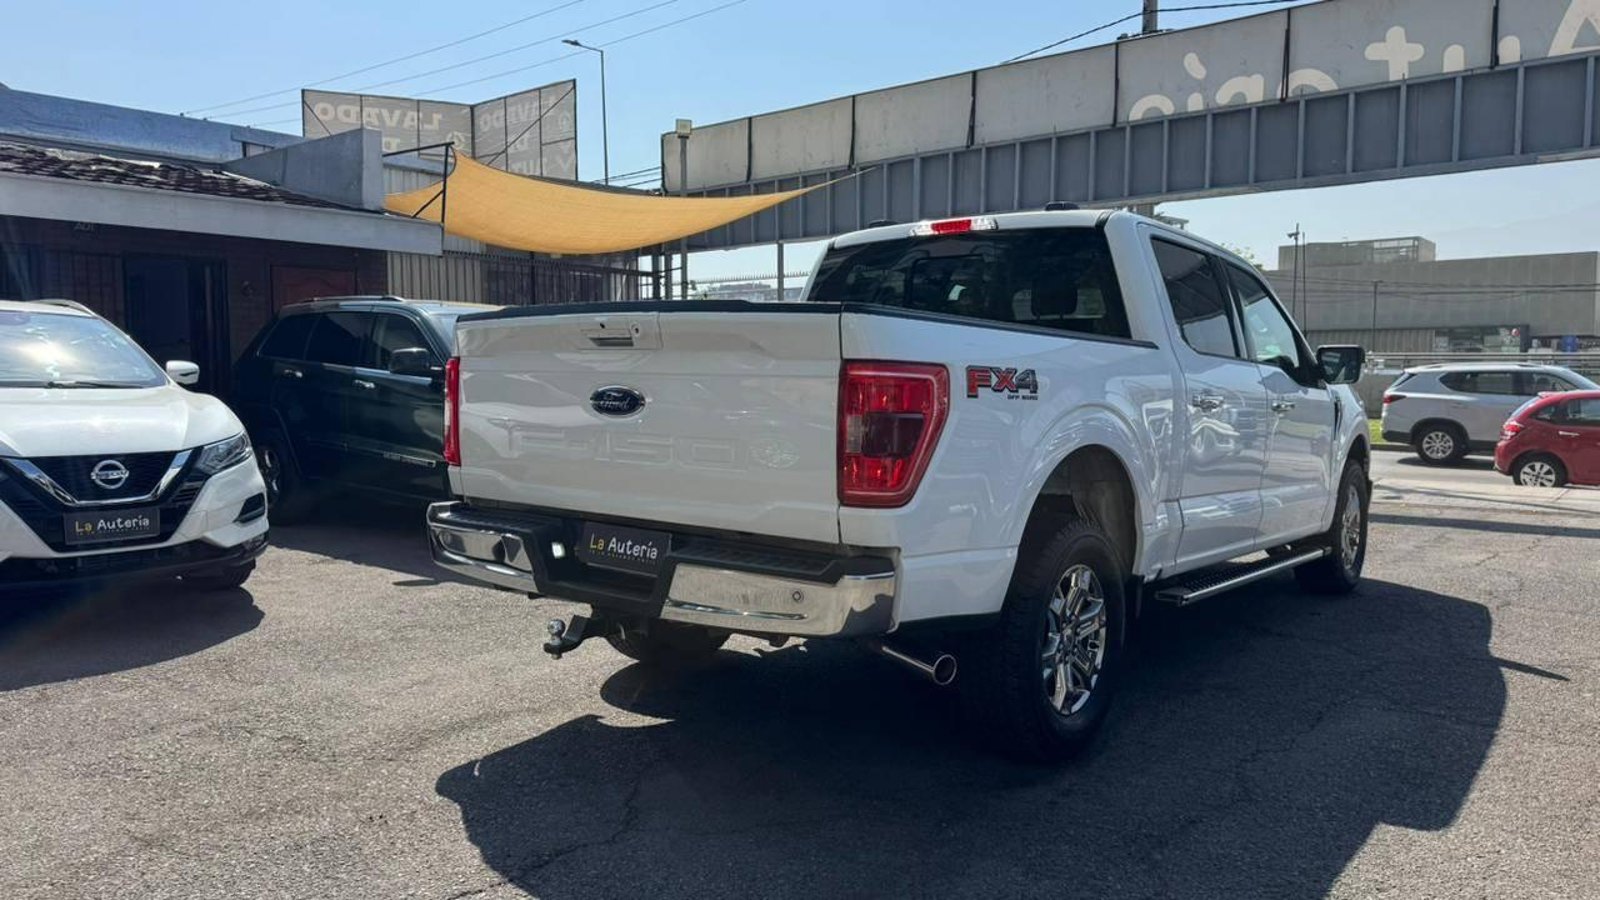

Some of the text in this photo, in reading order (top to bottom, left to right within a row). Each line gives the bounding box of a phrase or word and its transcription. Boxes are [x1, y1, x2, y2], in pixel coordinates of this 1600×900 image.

[965, 365, 1038, 398] FX4
[74, 519, 93, 533] La
[96, 514, 150, 531] Autería
[589, 532, 605, 551] La
[607, 536, 658, 560] Autería
